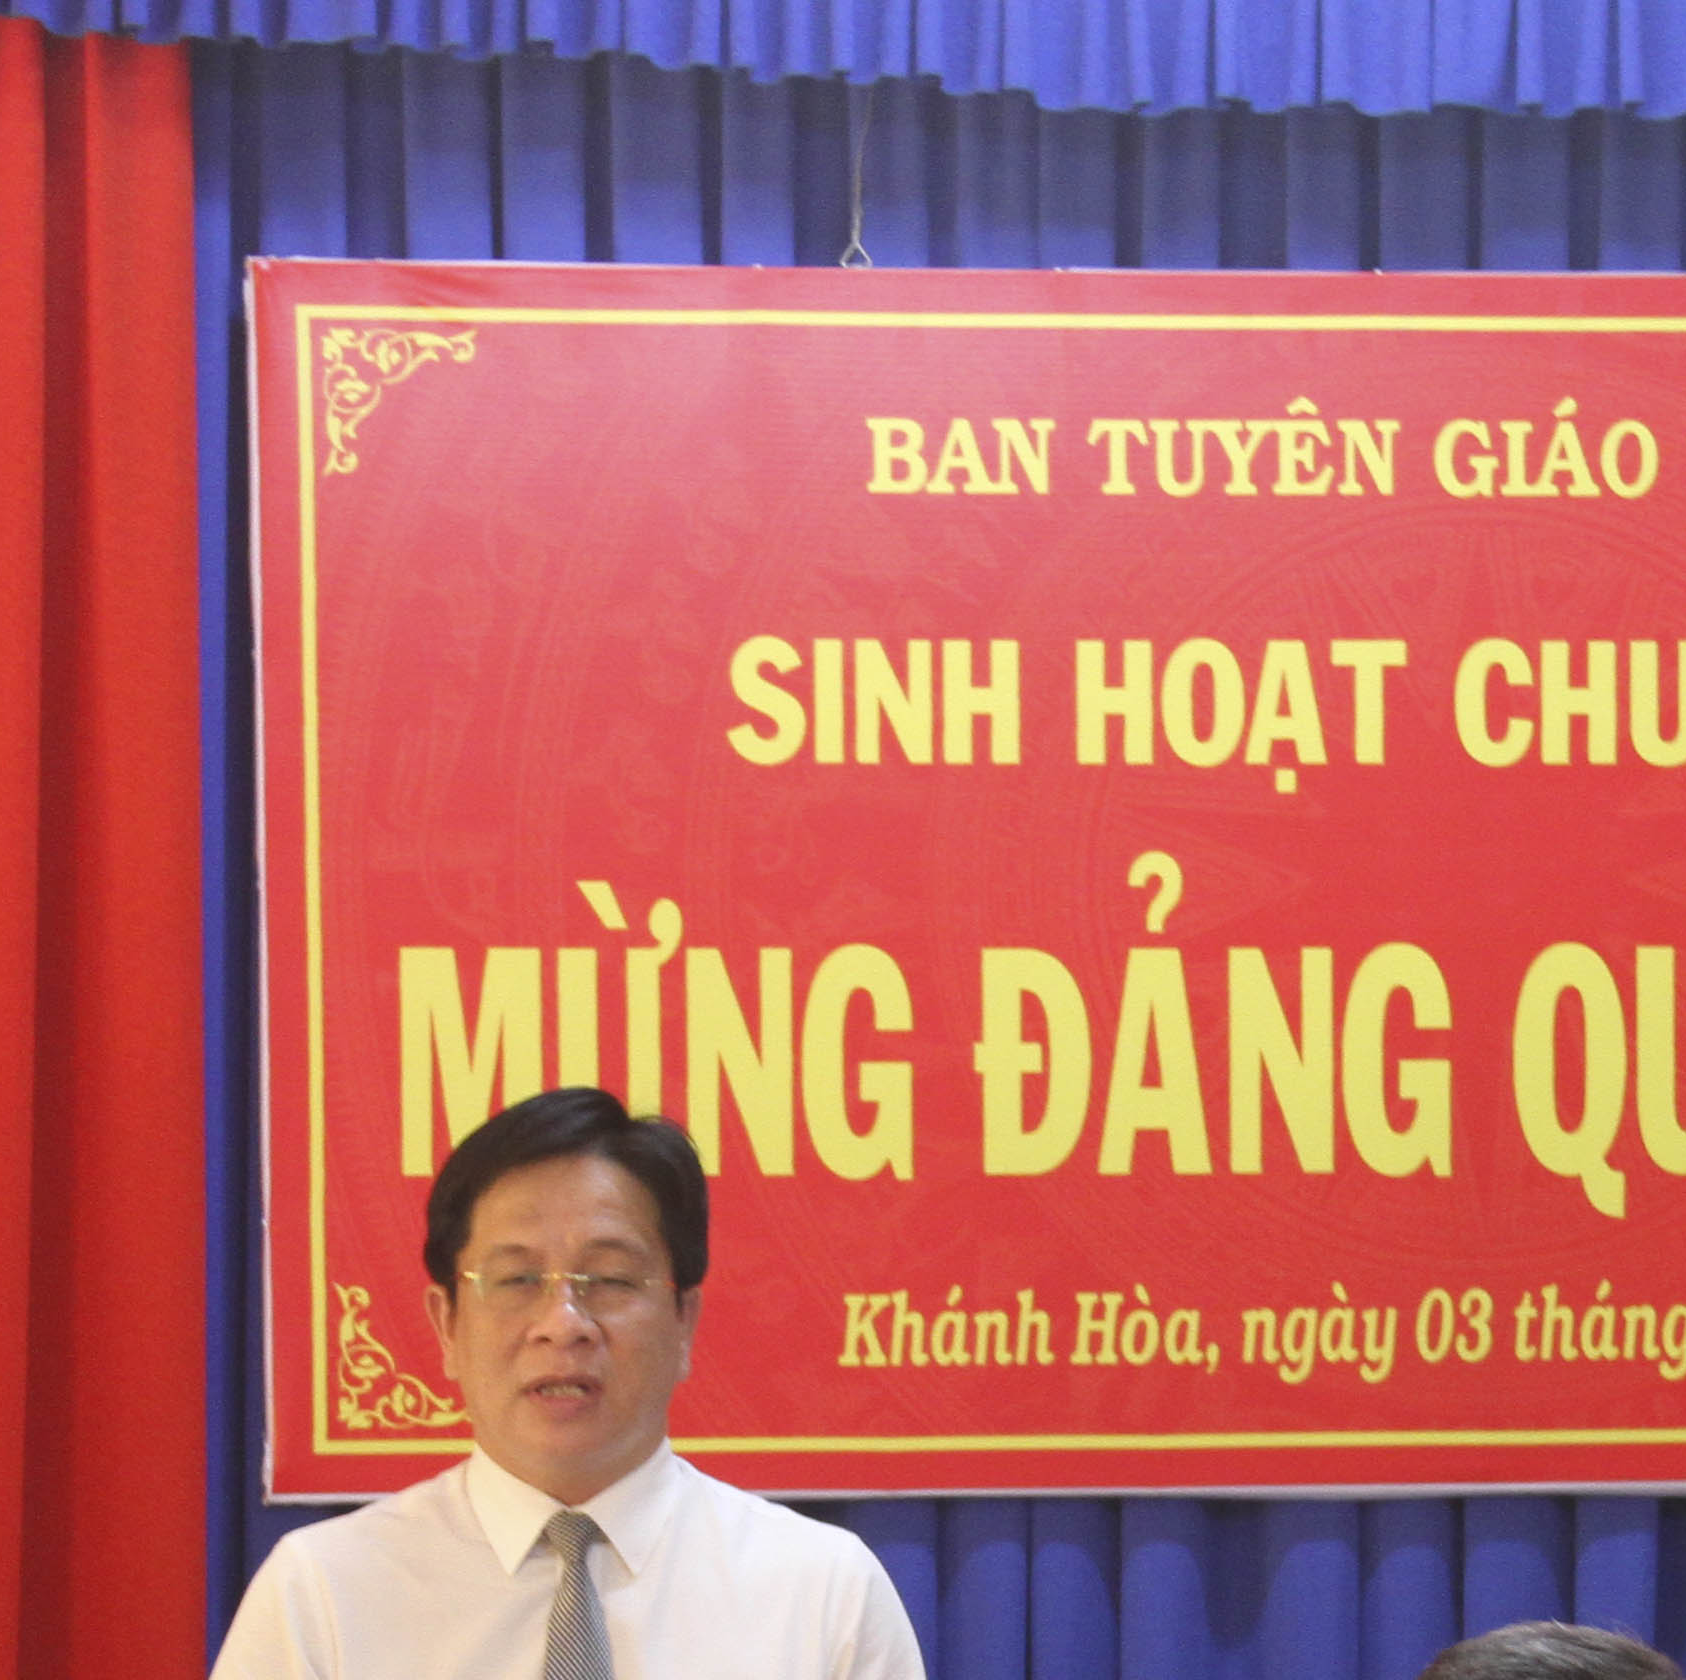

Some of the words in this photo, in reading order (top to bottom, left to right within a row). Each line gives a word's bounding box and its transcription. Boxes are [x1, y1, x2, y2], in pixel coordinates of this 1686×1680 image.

[865, 417, 1055, 496] BAN
[1084, 392, 1402, 498] TUYÊN
[1432, 396, 1661, 499] GIÁO
[725, 634, 1022, 767] SINH
[1073, 637, 1409, 795] HOẠT
[398, 879, 915, 1182] MỪNG
[972, 849, 1453, 1178] ĐẢNG
[837, 1288, 1055, 1367] Khánh
[1069, 1283, 1220, 1374] Hòa,
[1241, 1281, 1398, 1385] ngày
[1415, 1287, 1494, 1363] 03
